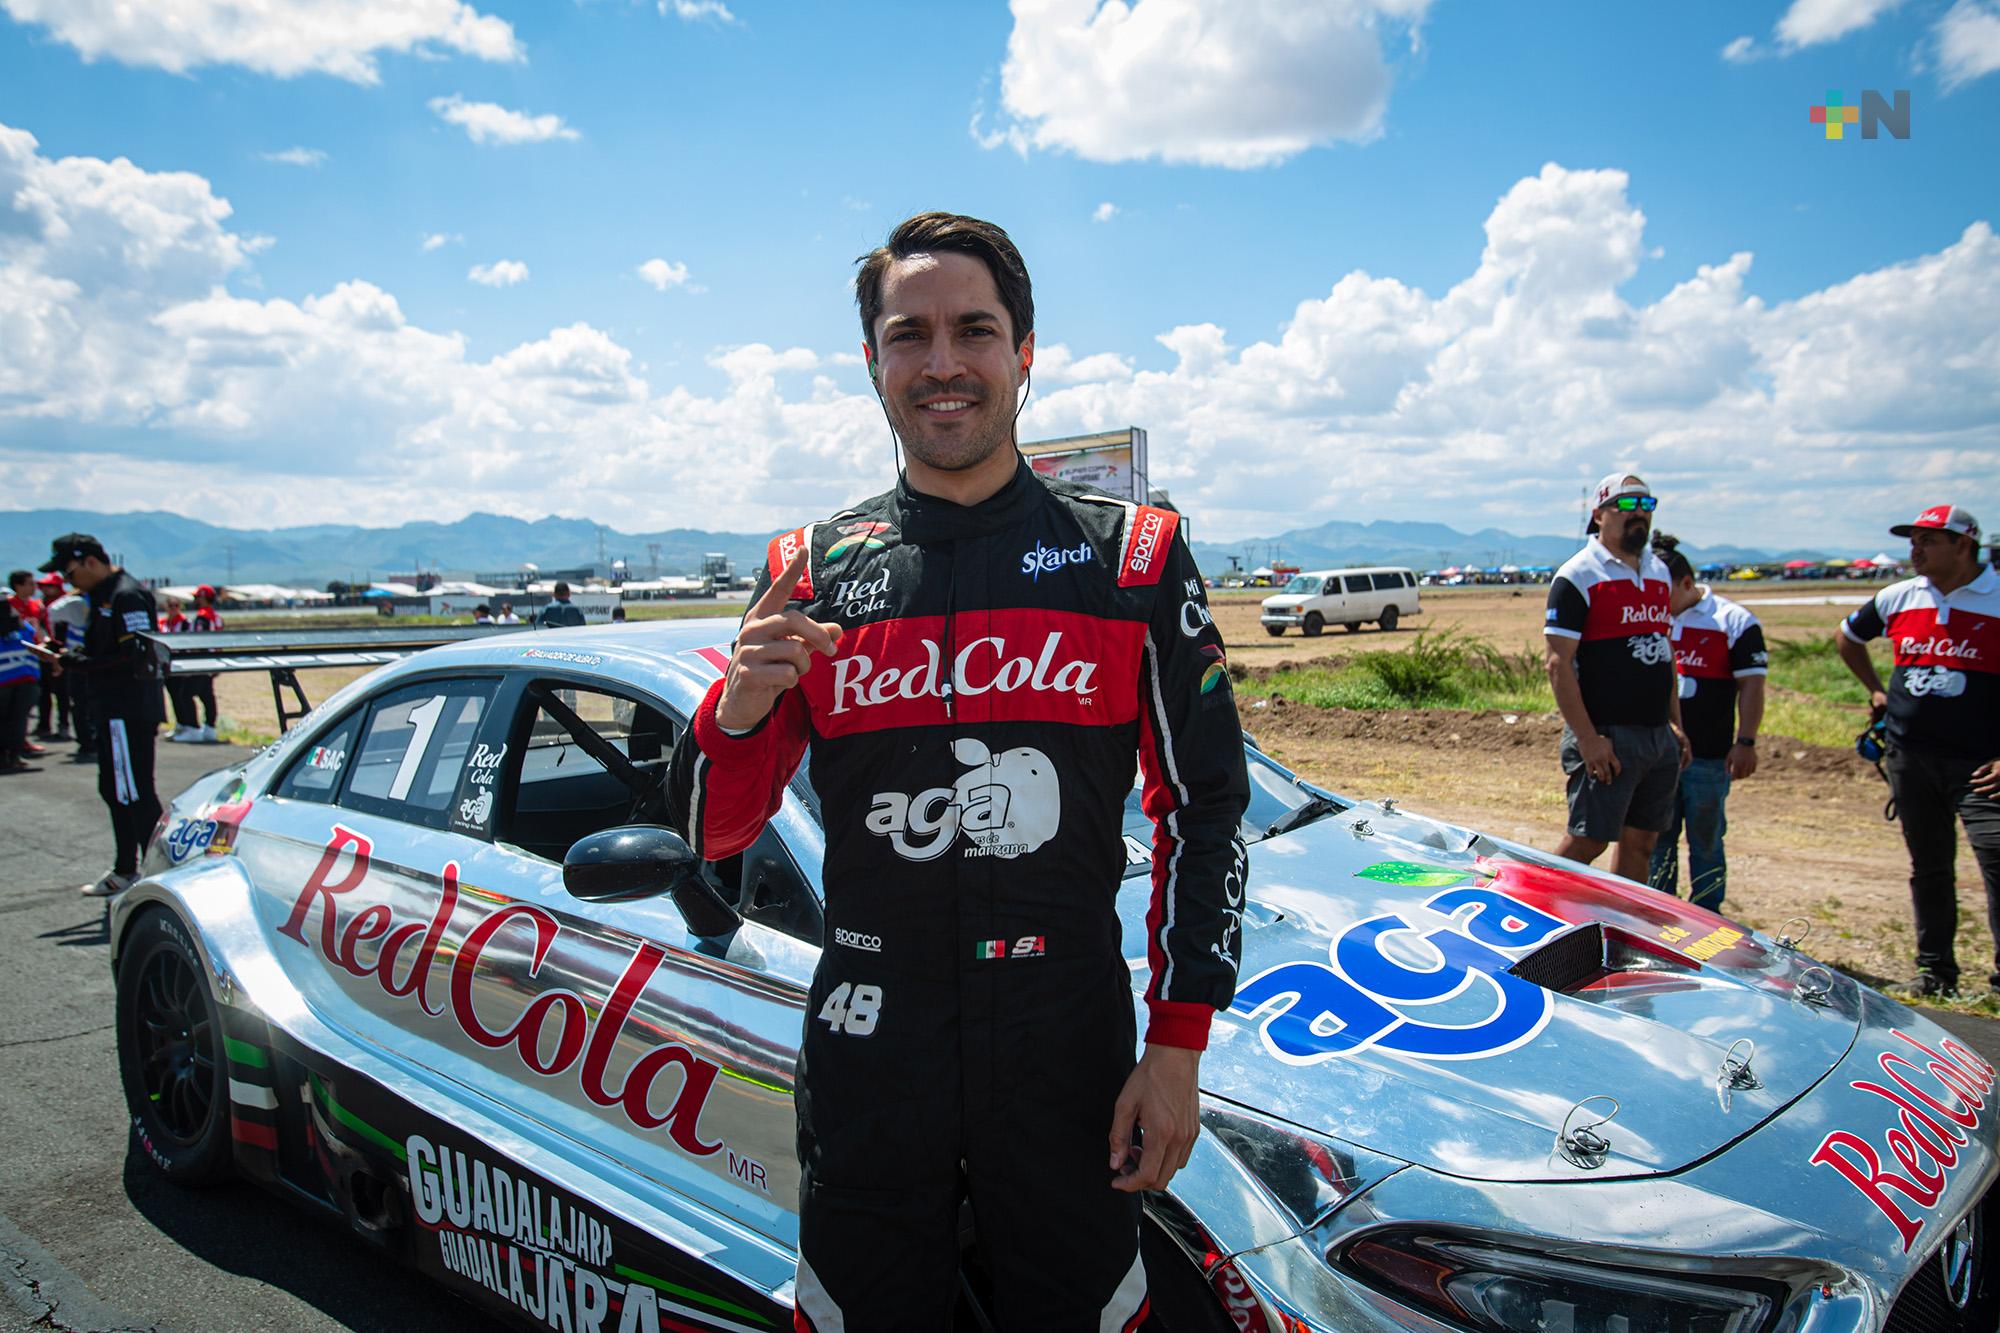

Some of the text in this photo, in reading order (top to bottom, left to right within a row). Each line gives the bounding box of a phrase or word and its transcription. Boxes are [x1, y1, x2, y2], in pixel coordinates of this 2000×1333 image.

[1130, 513, 1163, 574] sparco
[831, 568, 892, 607] Red
[846, 596, 886, 618] Cola
[1184, 579, 1200, 597] Mi
[1620, 604, 1647, 624] Red
[1900, 637, 1978, 659] Red Cola
[828, 632, 1098, 715] Red Cola
[319, 748, 345, 770] SAC
[389, 695, 447, 800] 1
[467, 743, 508, 768] Red
[470, 769, 494, 785] Cola
[460, 798, 485, 821] aga
[865, 782, 1011, 861] aga
[168, 818, 218, 864] aga
[964, 843, 1028, 858] manzana
[974, 832, 1000, 845] es de
[835, 927, 882, 952] sparco
[277, 822, 723, 1157] Red Cola
[1229, 886, 1573, 1066] aga
[817, 981, 883, 1036] 48
[1808, 1027, 1997, 1254] Red Cola
[728, 1151, 769, 1193] MR
[406, 1133, 613, 1267] GUADALAJARA
[439, 1229, 662, 1333] GUADALAJARA
